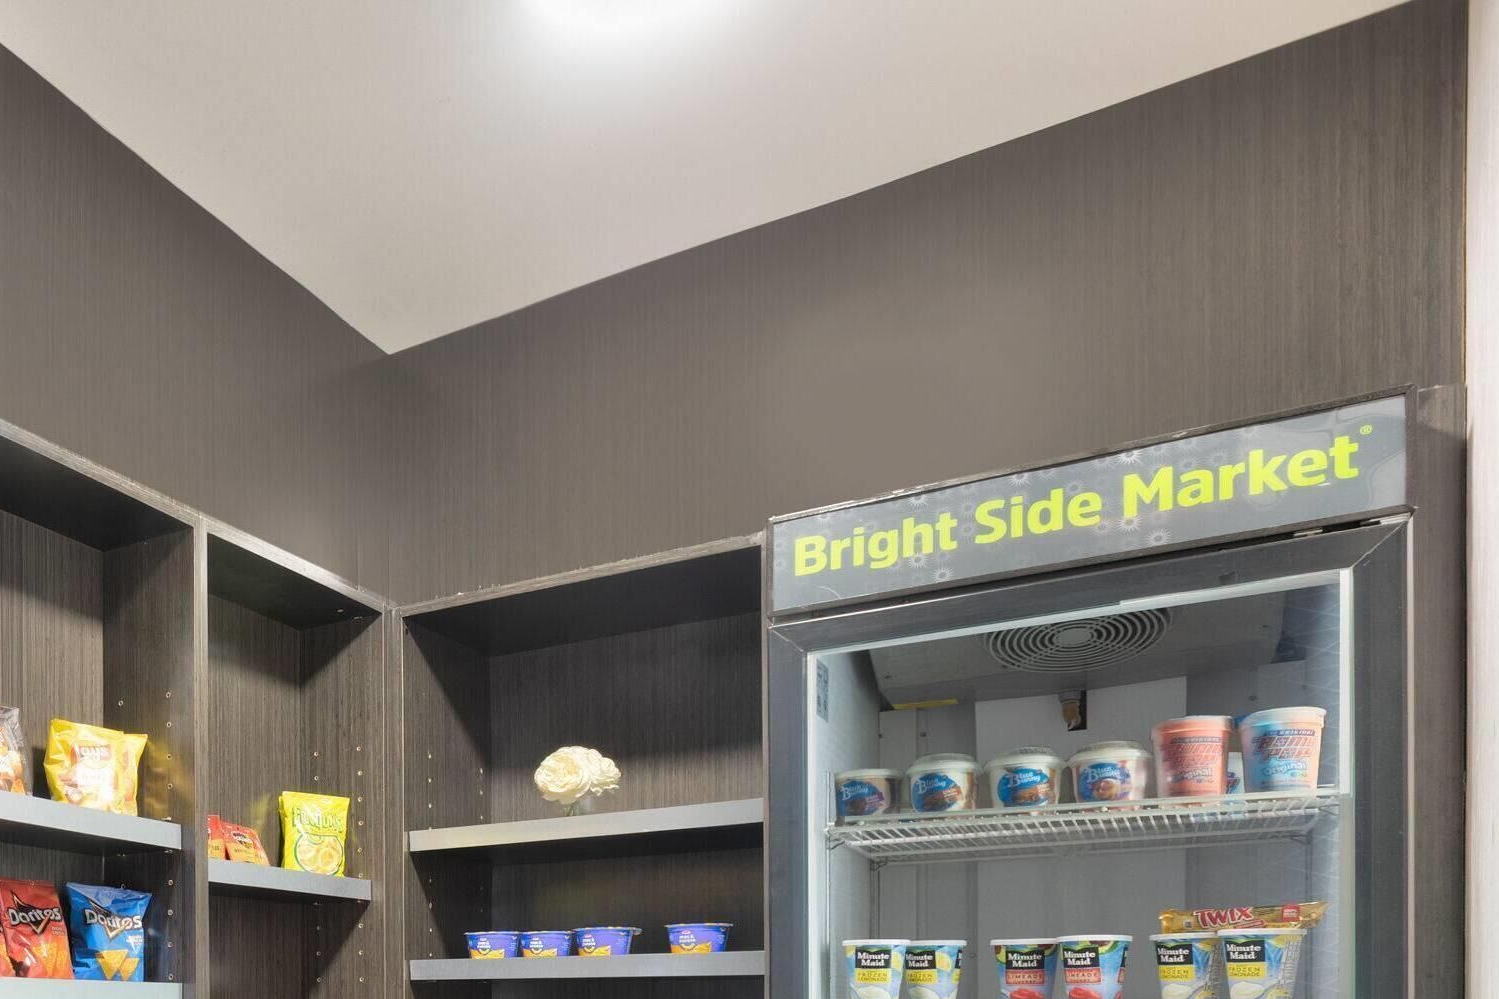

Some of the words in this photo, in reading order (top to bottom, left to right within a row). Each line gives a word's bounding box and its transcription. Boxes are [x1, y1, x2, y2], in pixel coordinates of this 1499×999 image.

[793, 513, 957, 577] Bright
[974, 489, 1101, 545] Side
[8, 905, 62, 925] Doritos
[85, 908, 143, 931] Doritos
[1195, 906, 1253, 929] TWIX
[1157, 947, 1190, 957] Minute
[1226, 943, 1261, 953] Minute
[857, 951, 890, 961] Minute
[1008, 952, 1043, 962] Minute
[1063, 950, 1096, 960] Minute
[1160, 954, 1185, 963] Maid
[1229, 951, 1257, 960] Maid
[861, 958, 885, 967] Maid
[908, 958, 929, 967] Maid
[1012, 959, 1037, 968] Maid
[1067, 957, 1091, 966] Maid
